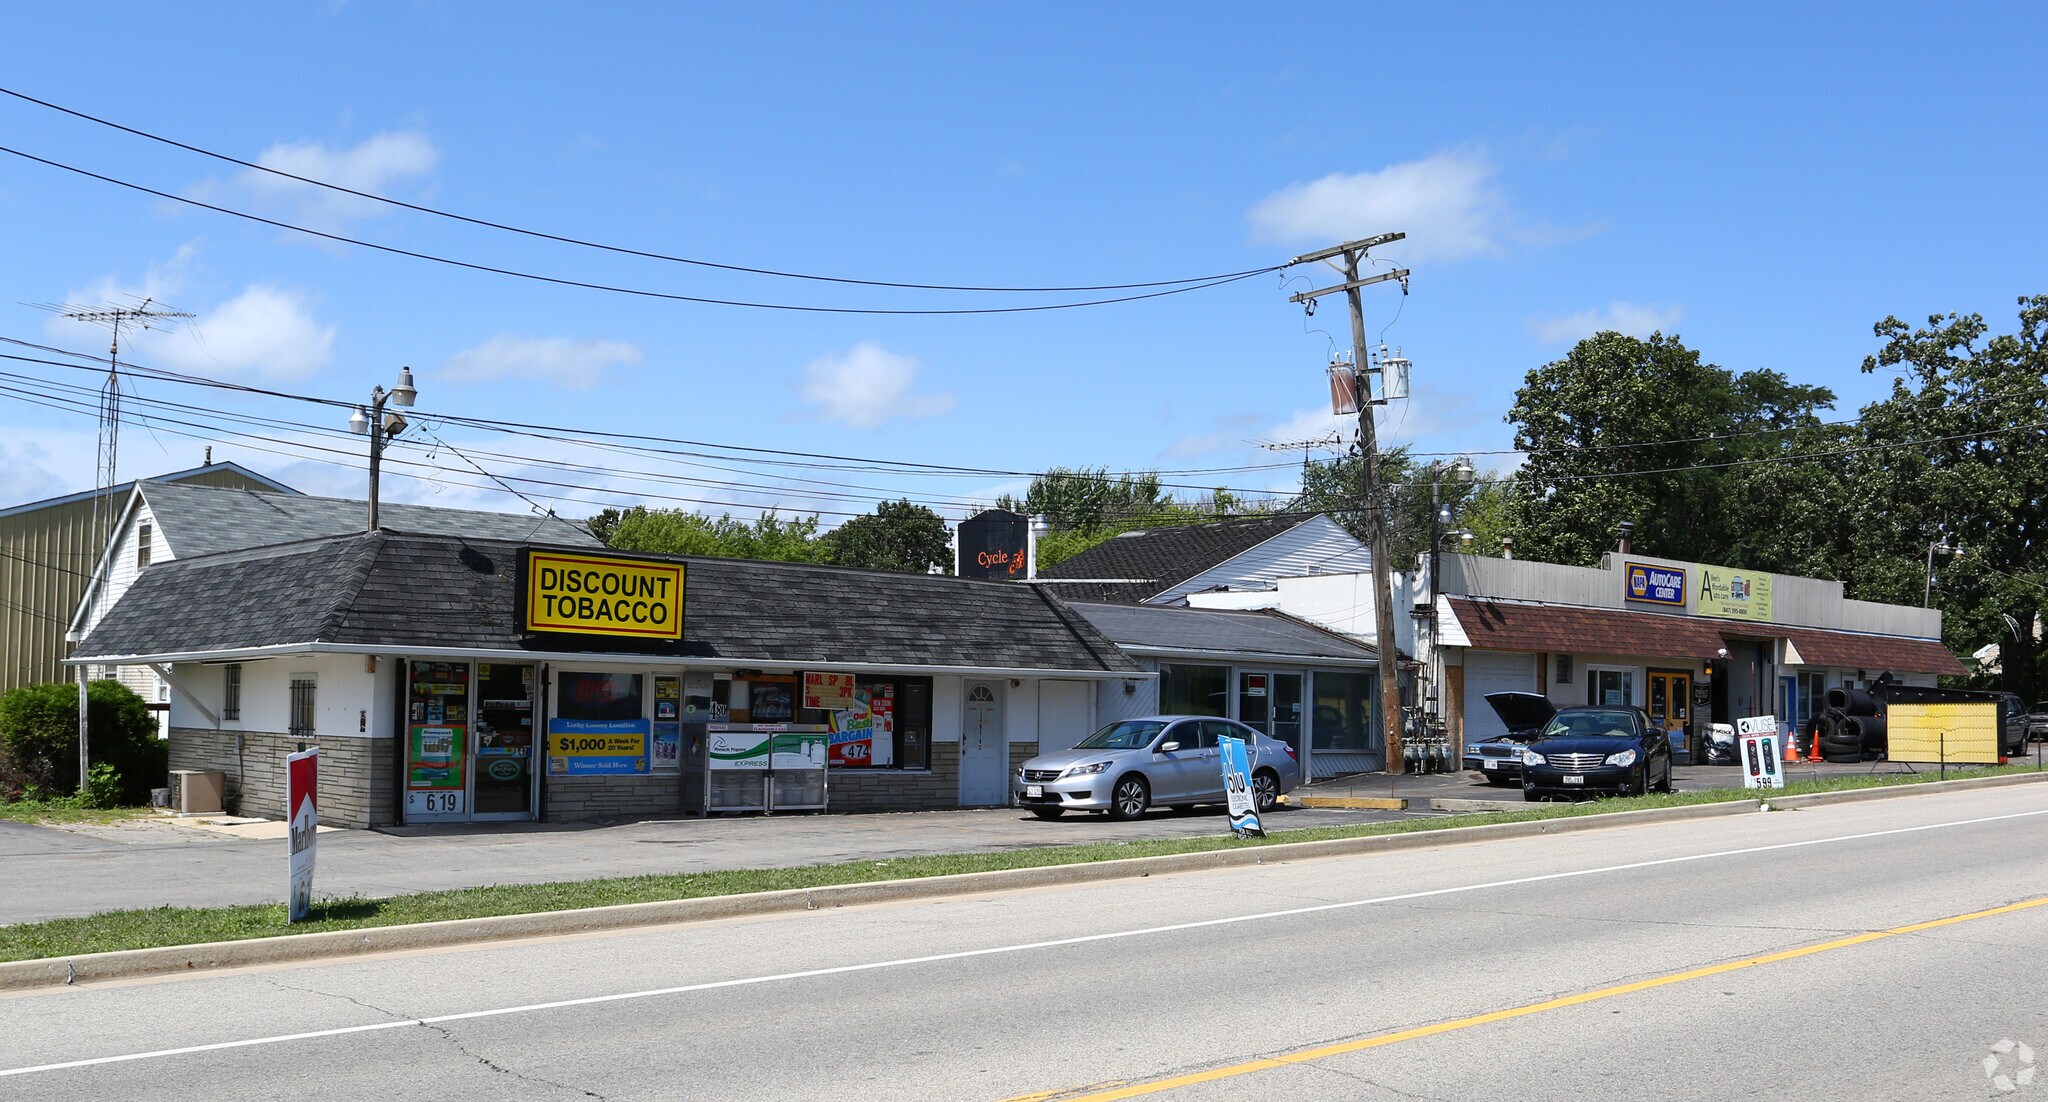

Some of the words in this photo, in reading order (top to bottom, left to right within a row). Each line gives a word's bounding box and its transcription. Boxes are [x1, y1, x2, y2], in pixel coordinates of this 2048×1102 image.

[977, 550, 1009, 568] Cycle
[541, 567, 672, 598] DISCOUNT
[1655, 587, 1675, 599] CENTER
[542, 594, 668, 625] TOBACCO
[805, 673, 823, 685] MARL
[828, 675, 838, 685] SP
[845, 676, 854, 686] BL
[805, 686, 810, 694] S
[839, 686, 852, 698] 3PK
[805, 696, 821, 707] TIME
[847, 718, 871, 731] Best
[1749, 718, 1774, 732] VUSE
[559, 737, 606, 753] $1,000
[598, 761, 612, 769] Sold
[1223, 762, 1246, 794] blu
[409, 795, 415, 804] $
[427, 794, 456, 812] 6.19
[291, 815, 317, 856] Marlbor
